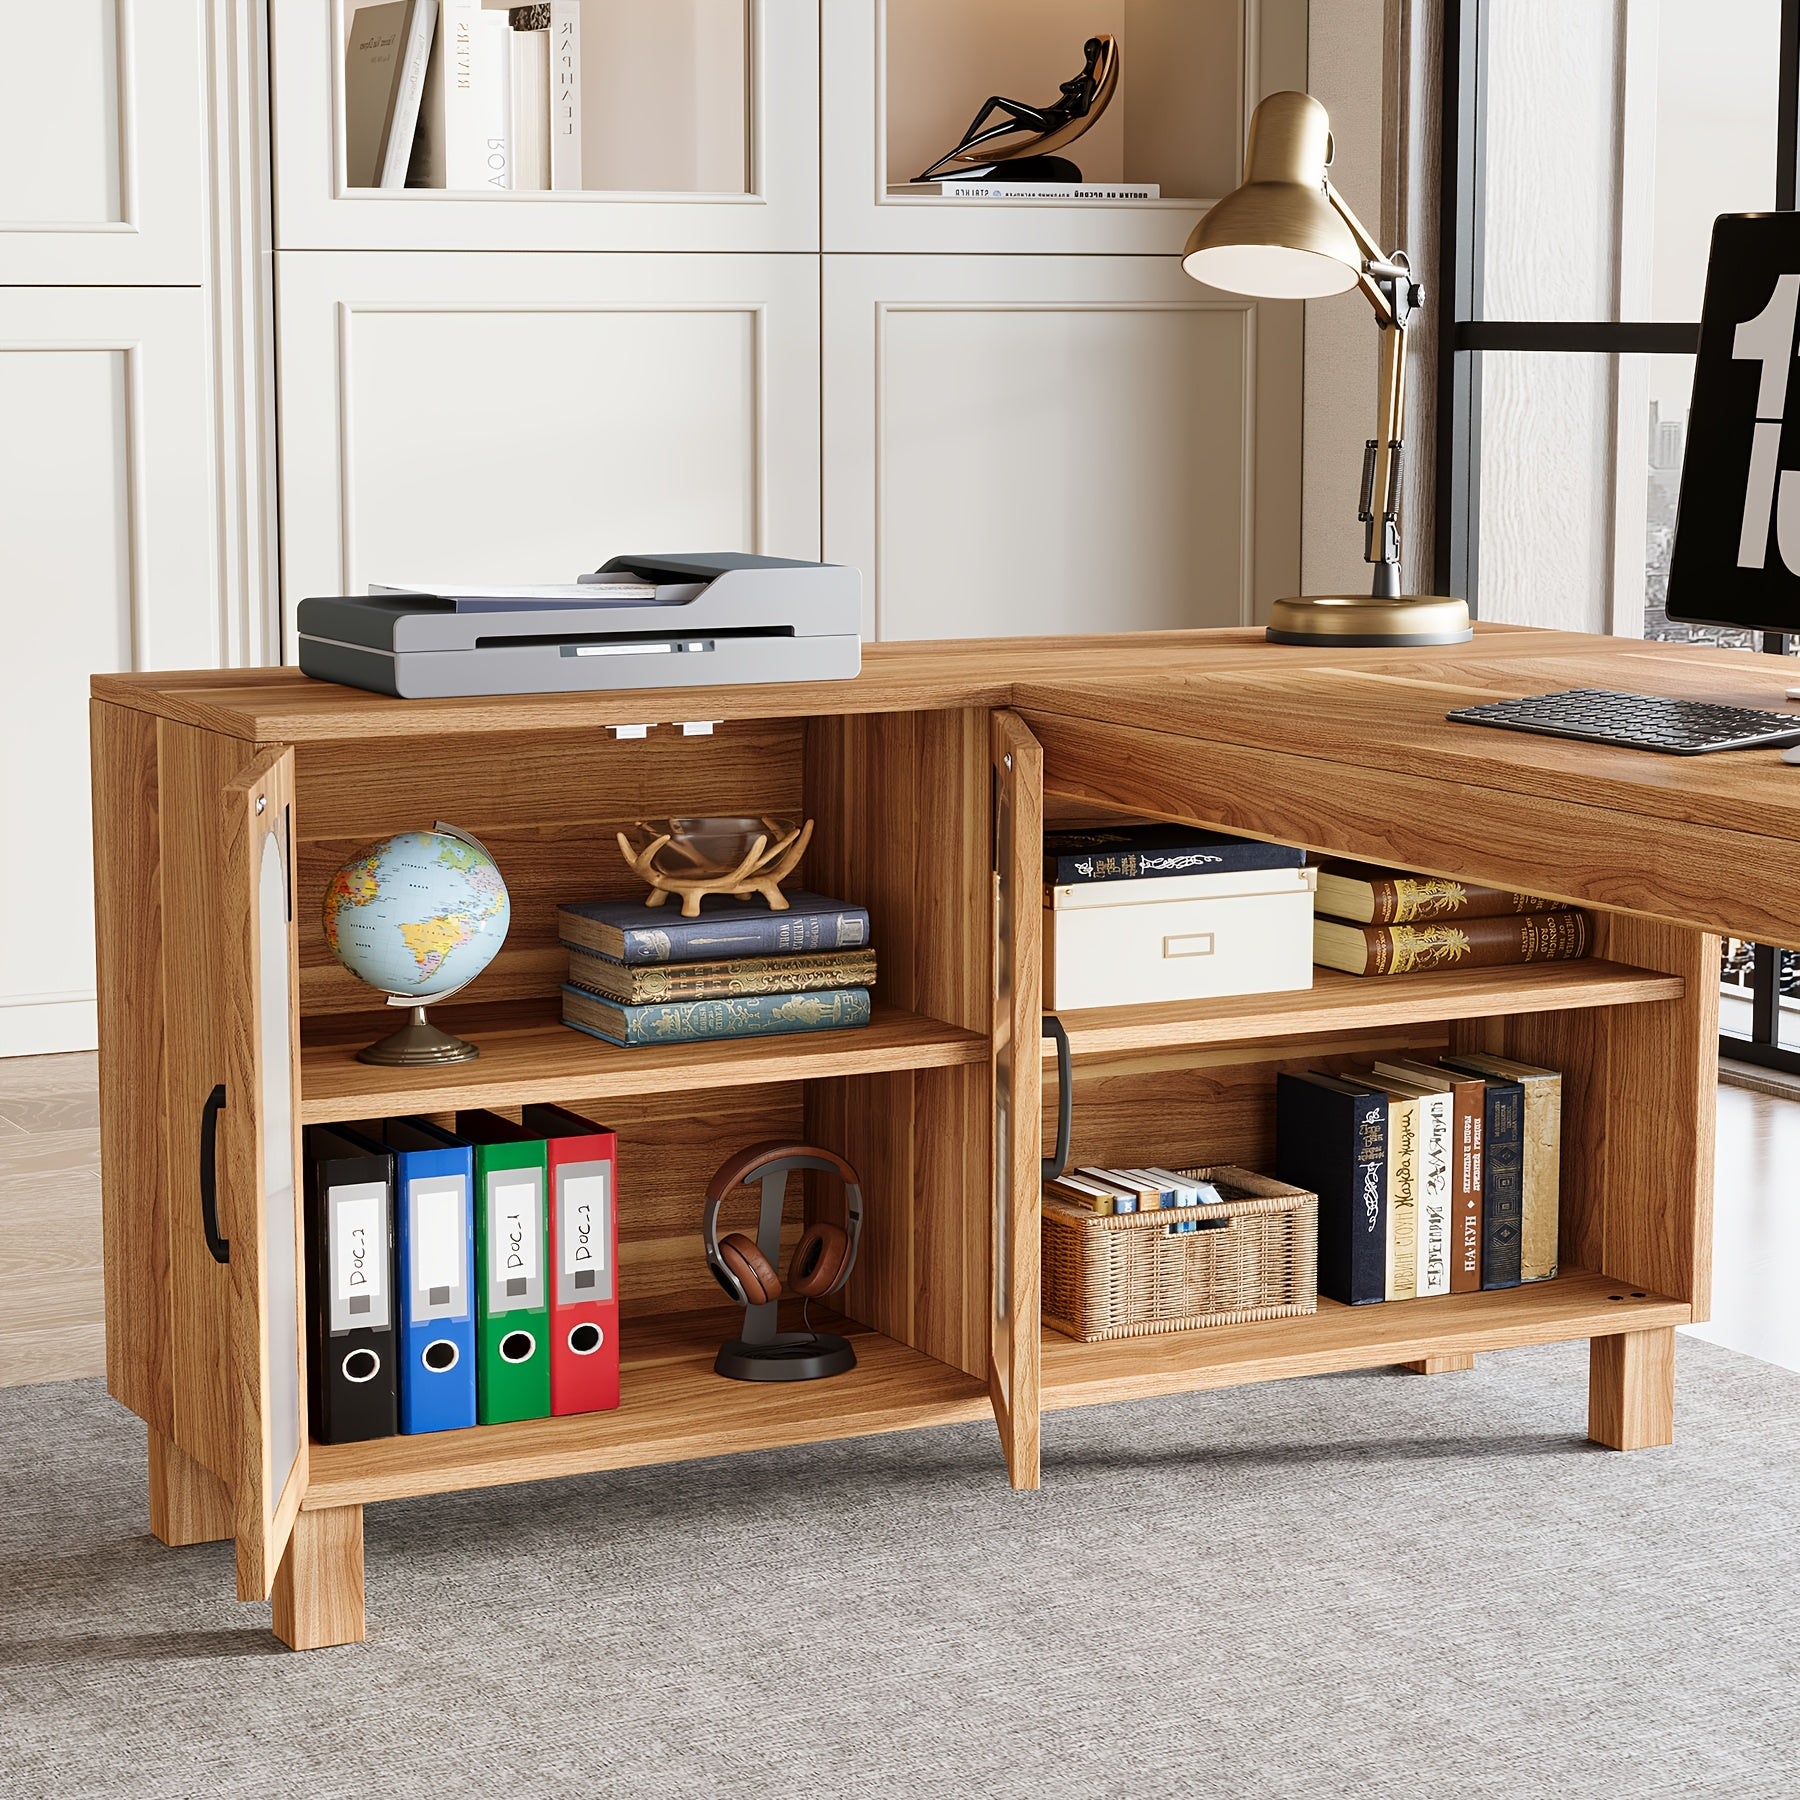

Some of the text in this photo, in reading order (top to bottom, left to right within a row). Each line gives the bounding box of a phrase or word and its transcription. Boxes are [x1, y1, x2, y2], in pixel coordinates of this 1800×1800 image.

[1732, 274, 1800, 578] 1
[779, 923, 790, 949] WORK
[1540, 927, 1548, 953] ROAD
[1547, 917, 1557, 959] CORNICHE
[1563, 928, 1574, 958] RIVIERA
[1394, 1108, 1415, 1292] ИРВИНГ СТОУН Жажда жизни
